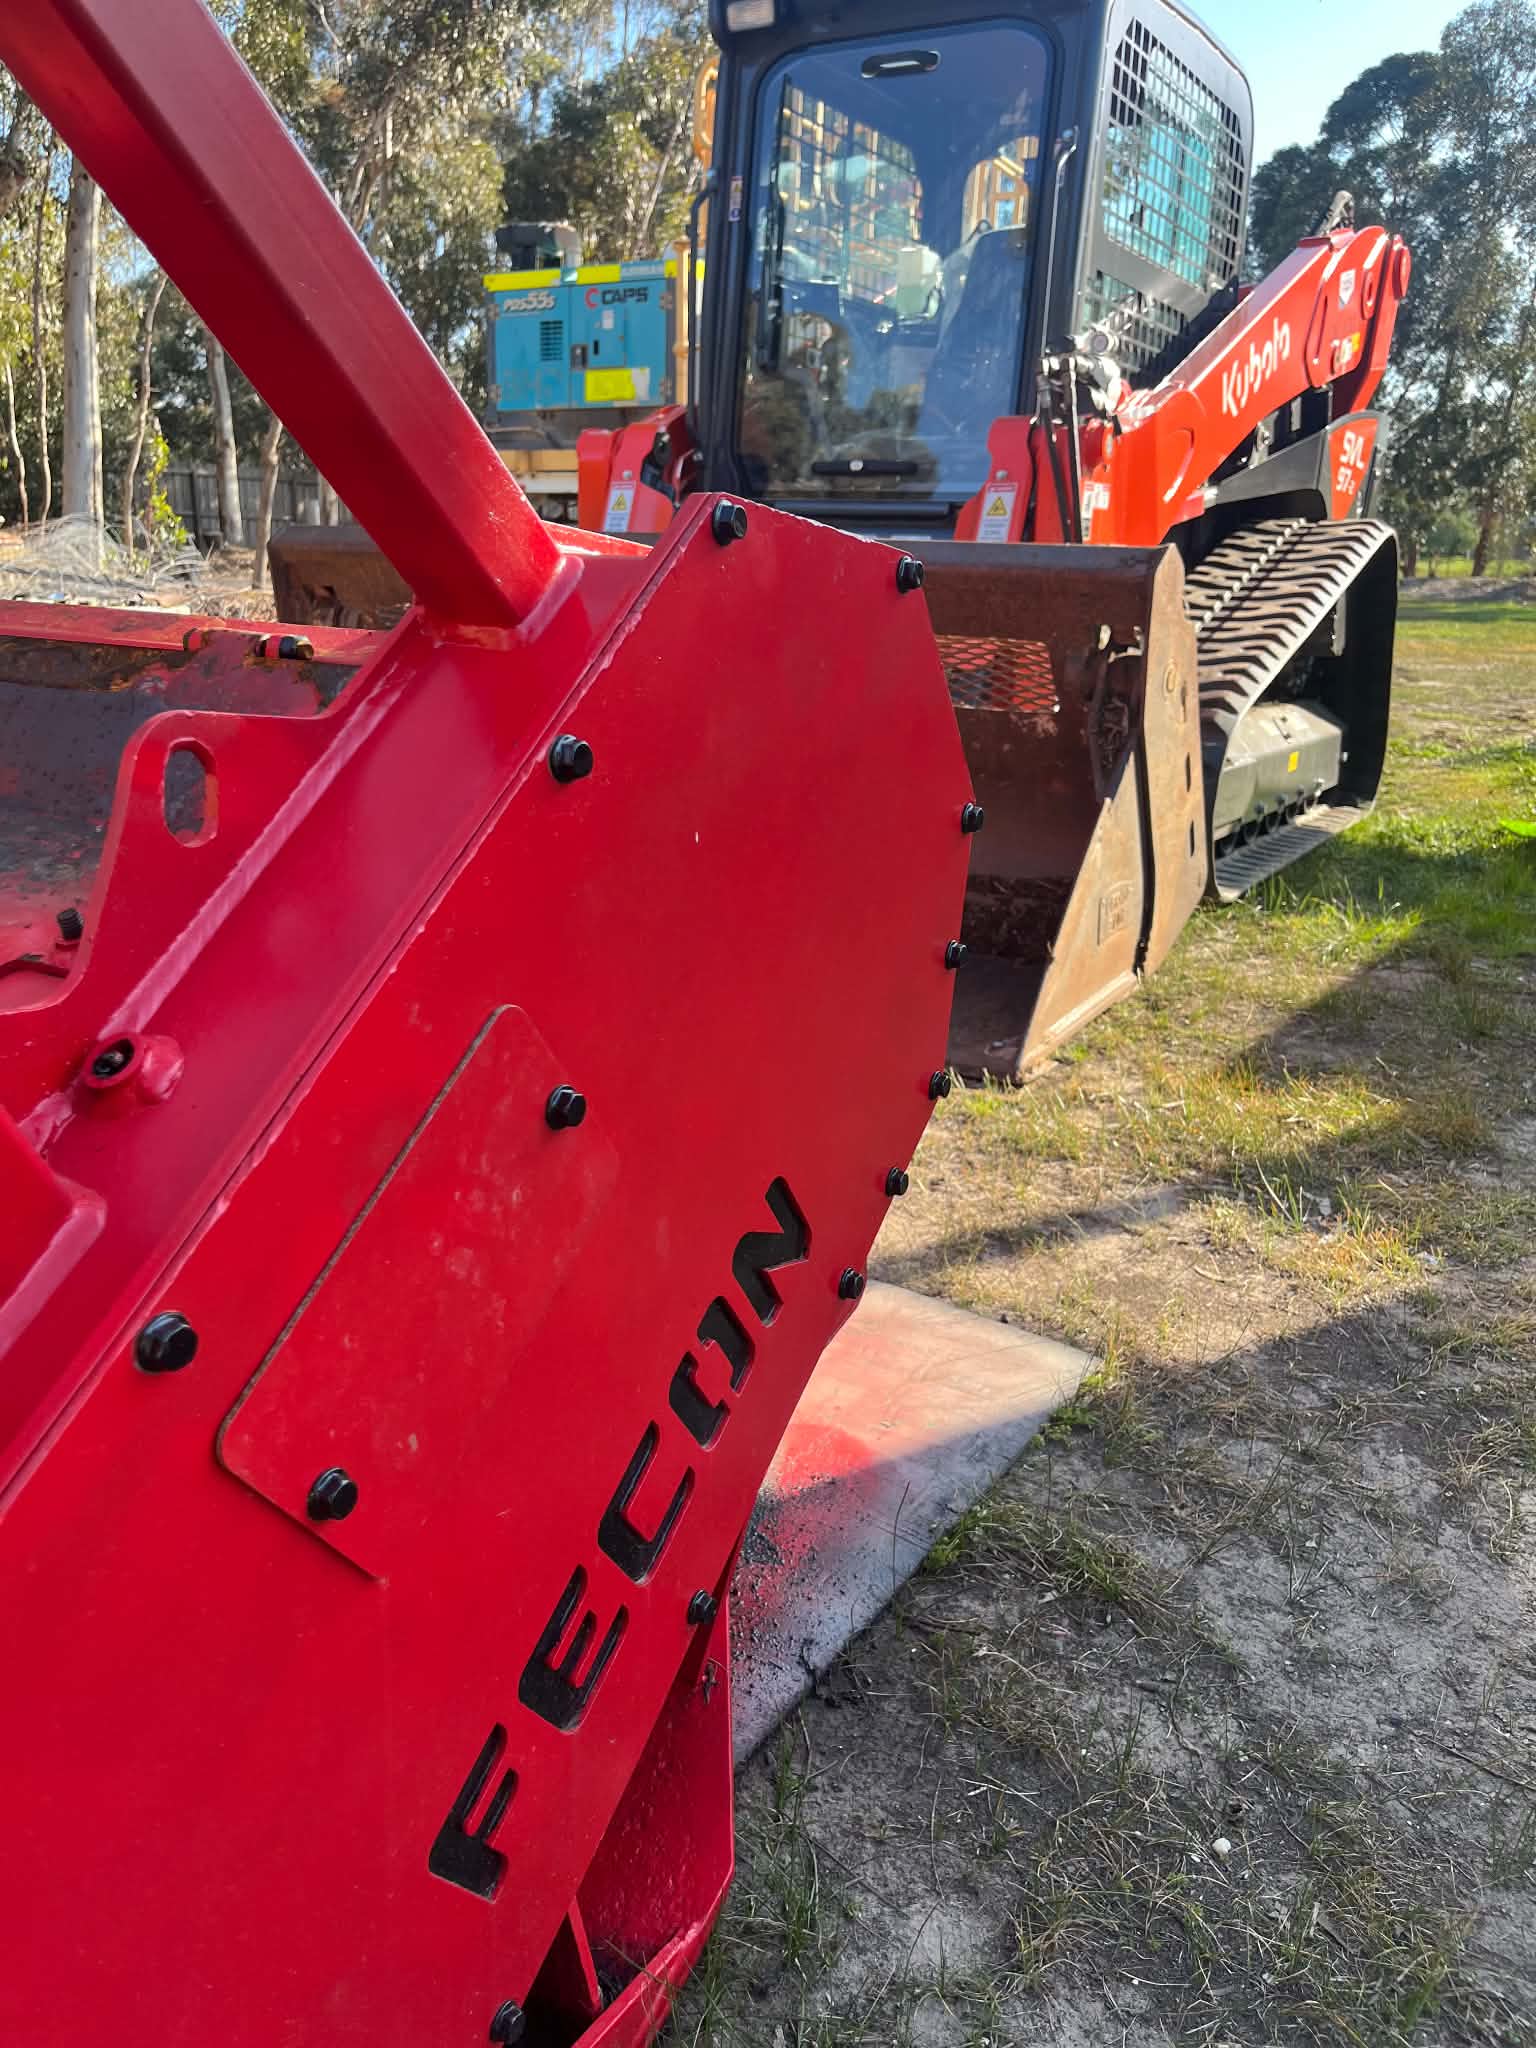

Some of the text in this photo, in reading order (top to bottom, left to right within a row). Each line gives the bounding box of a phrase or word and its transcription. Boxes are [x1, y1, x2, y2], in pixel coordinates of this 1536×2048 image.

[602, 287, 648, 304] CAPS
[1221, 318, 1290, 416] Kubota
[1339, 430, 1365, 470] SVL
[428, 1175, 812, 1903] FECON
